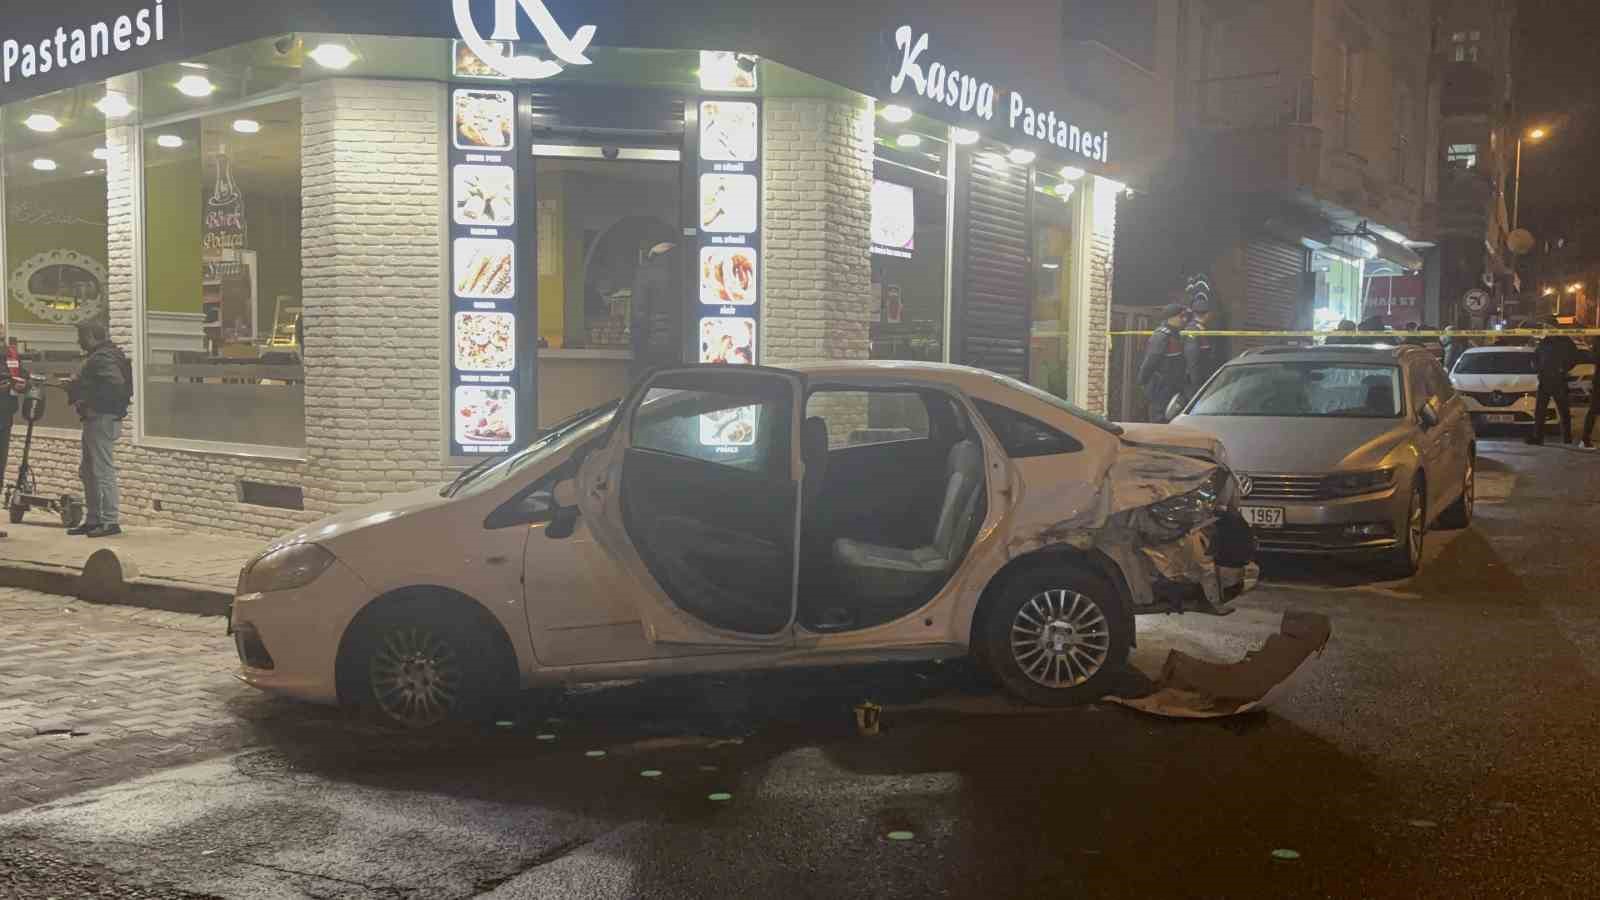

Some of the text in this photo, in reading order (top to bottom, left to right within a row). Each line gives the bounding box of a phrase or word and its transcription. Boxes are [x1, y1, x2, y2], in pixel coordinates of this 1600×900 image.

[3, 0, 164, 83] Pastanesi
[890, 25, 1109, 164] Kasva Pastanesi
[1251, 508, 1281, 523] 1967
